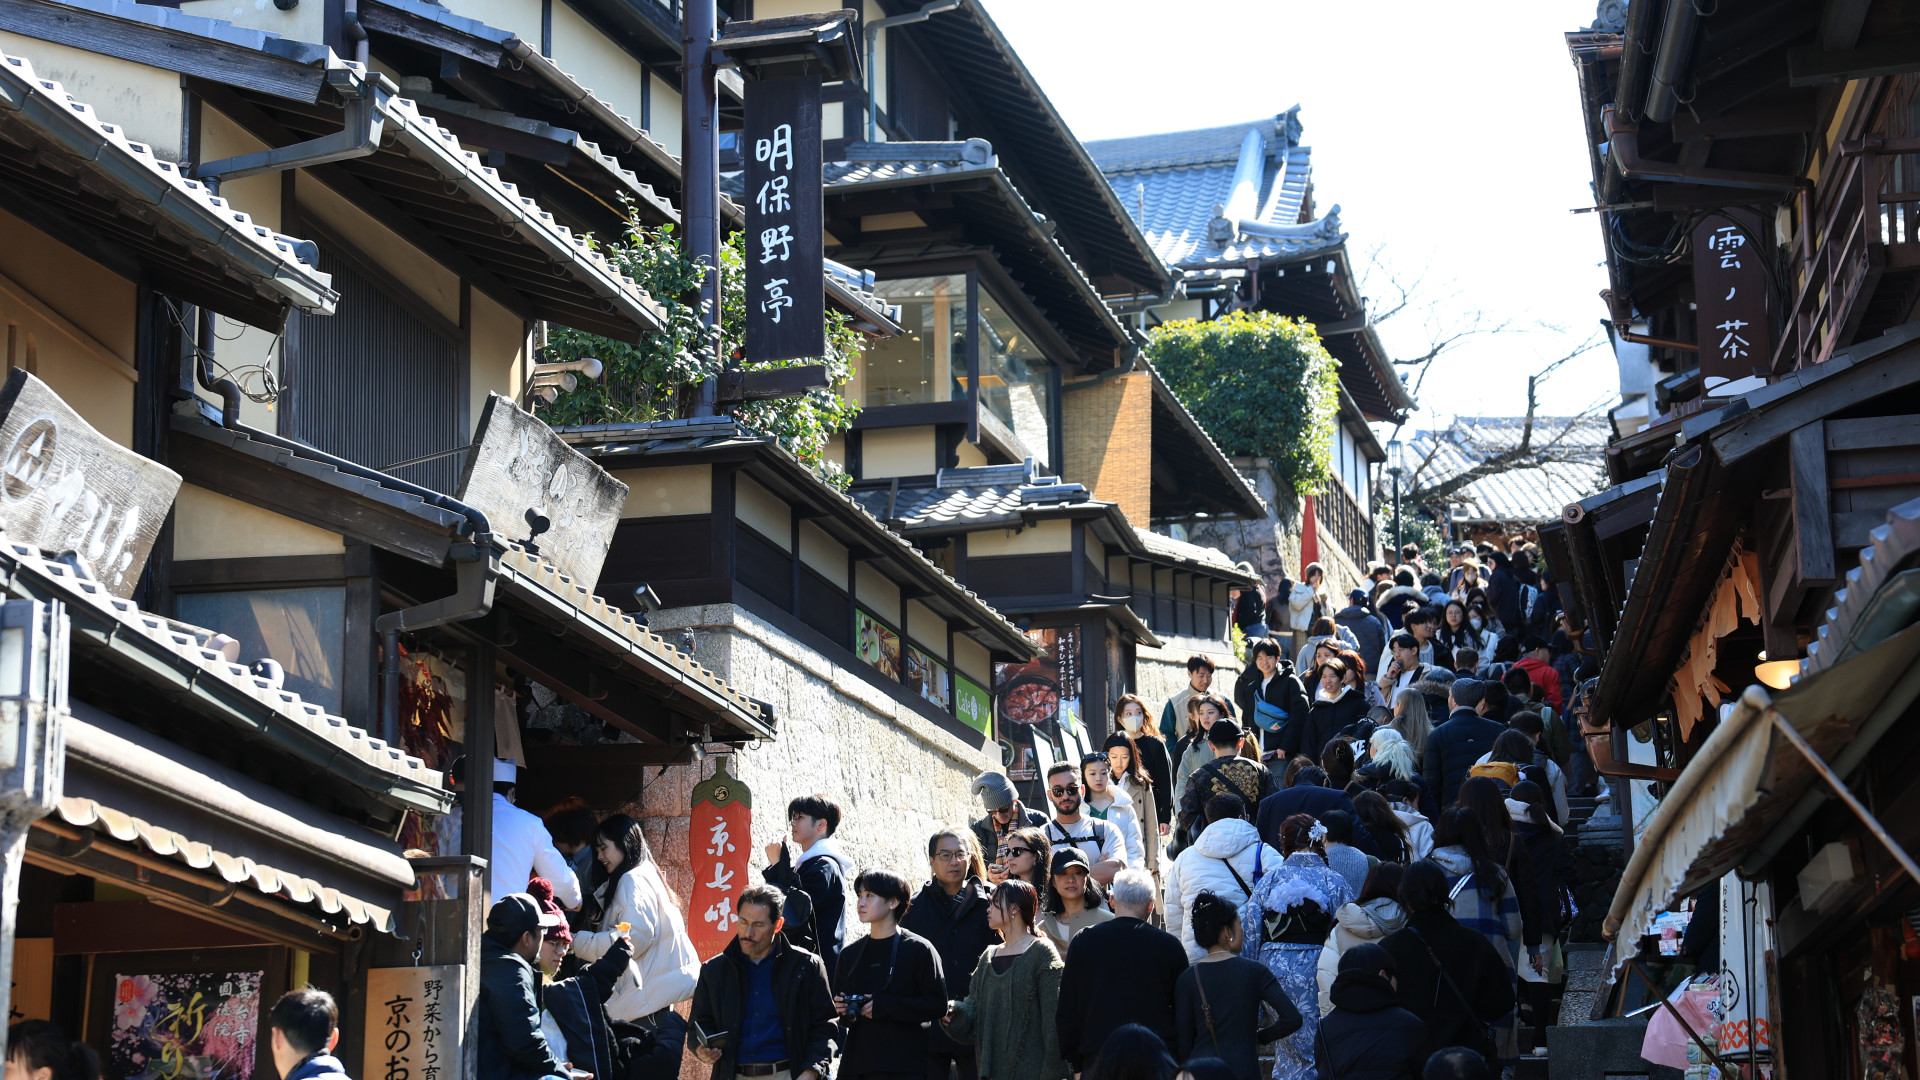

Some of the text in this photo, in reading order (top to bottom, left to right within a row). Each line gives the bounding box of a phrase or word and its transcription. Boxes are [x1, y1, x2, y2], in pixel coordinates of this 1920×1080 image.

[755, 123, 794, 324] 明保野亭
[1708, 225, 1750, 359] 雲ノ茶
[704, 816, 740, 932] 京七味
[698, 939, 728, 948] KYOT
[149, 991, 209, 1080] 祈り
[231, 980, 254, 1045] 高台寺
[384, 994, 413, 1080] 京のお
